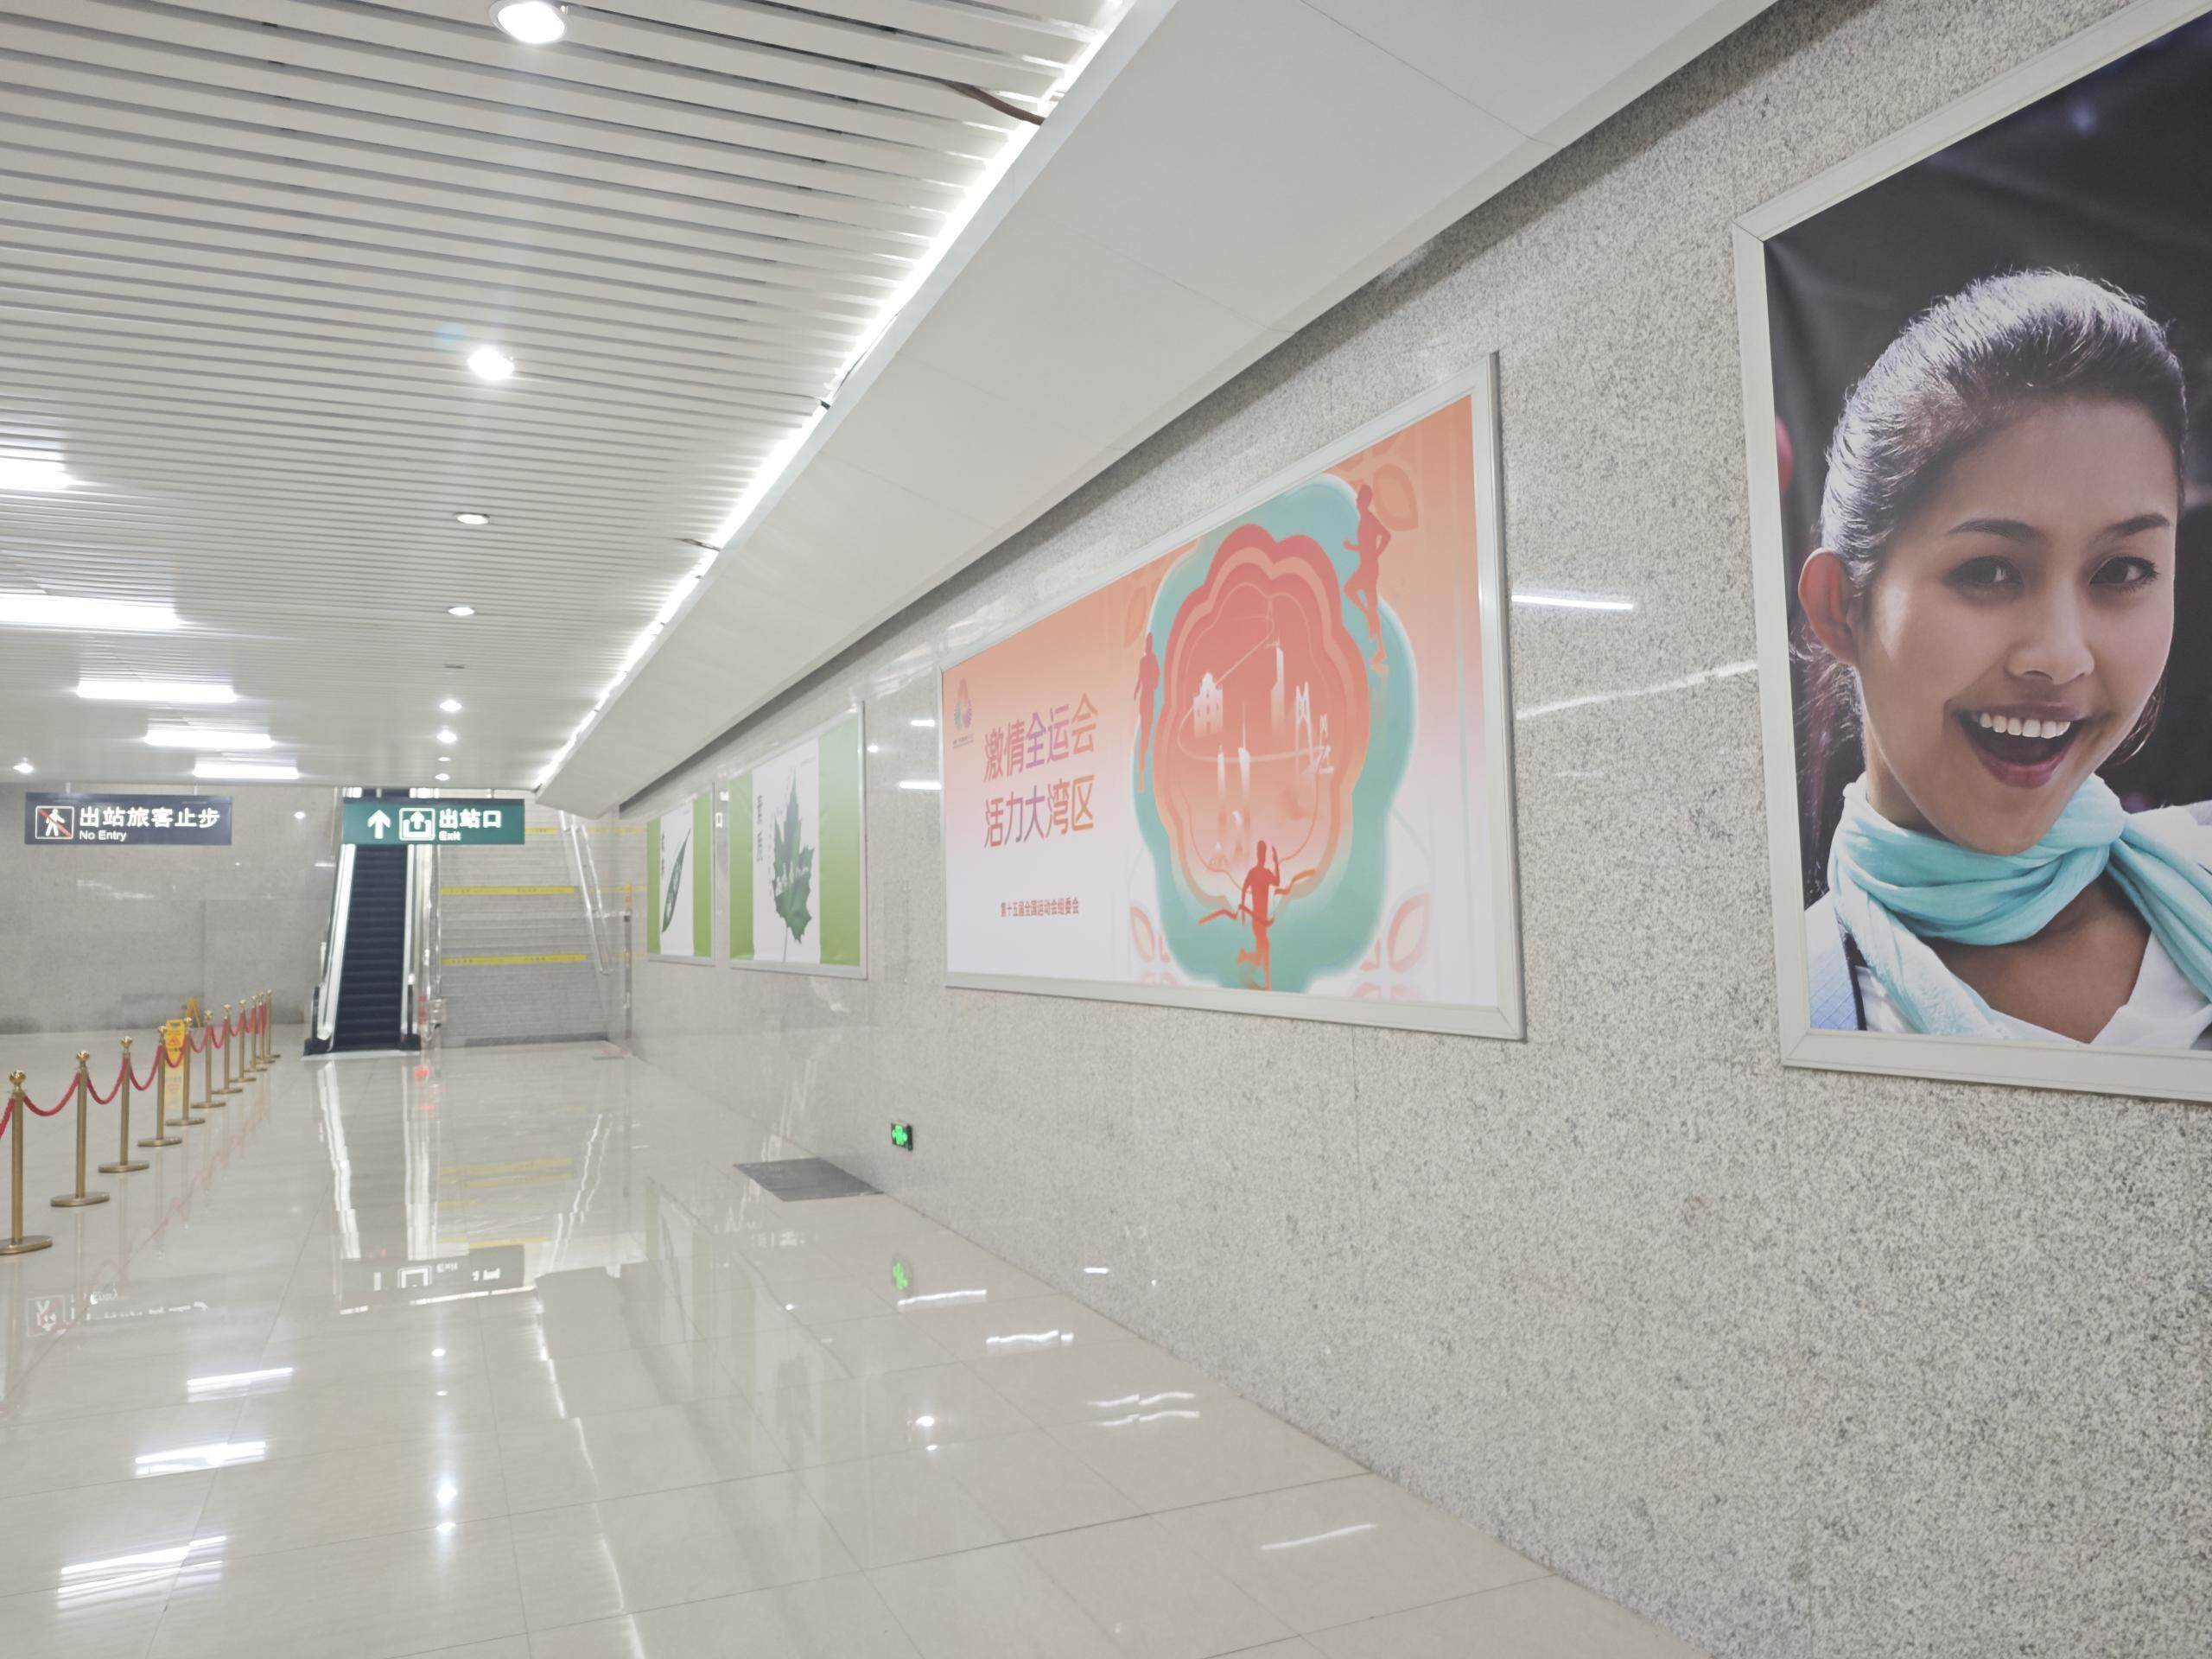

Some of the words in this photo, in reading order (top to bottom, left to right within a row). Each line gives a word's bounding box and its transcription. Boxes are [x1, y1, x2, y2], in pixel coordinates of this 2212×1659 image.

[983, 692, 1099, 782] 激情全运会
[79, 806, 220, 828] 出站旅客止步
[439, 808, 501, 829] 出站口
[983, 774, 1096, 849] 活力大湾区
[79, 830, 96, 840] No
[98, 830, 127, 842] Entry
[439, 830, 461, 841] Exit
